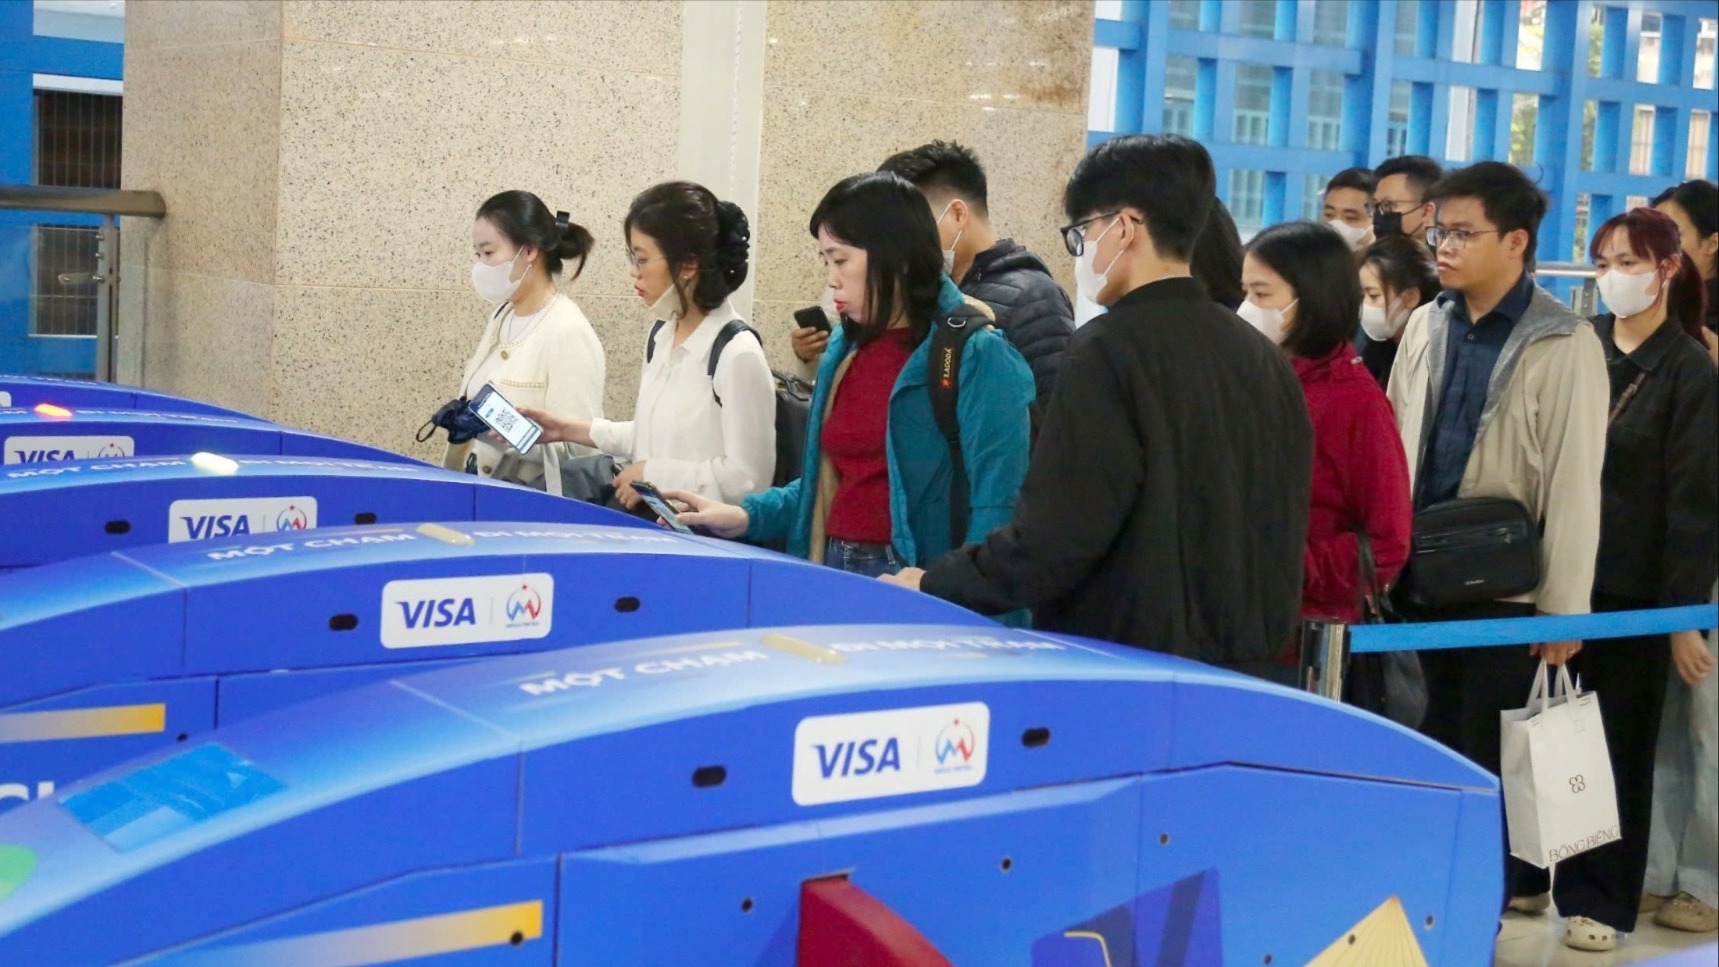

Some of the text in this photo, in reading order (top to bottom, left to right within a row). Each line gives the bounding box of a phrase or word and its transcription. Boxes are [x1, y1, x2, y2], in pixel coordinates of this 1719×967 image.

[180, 514, 250, 540] VISA
[395, 597, 476, 629] VISA
[811, 737, 901, 779] VISA
